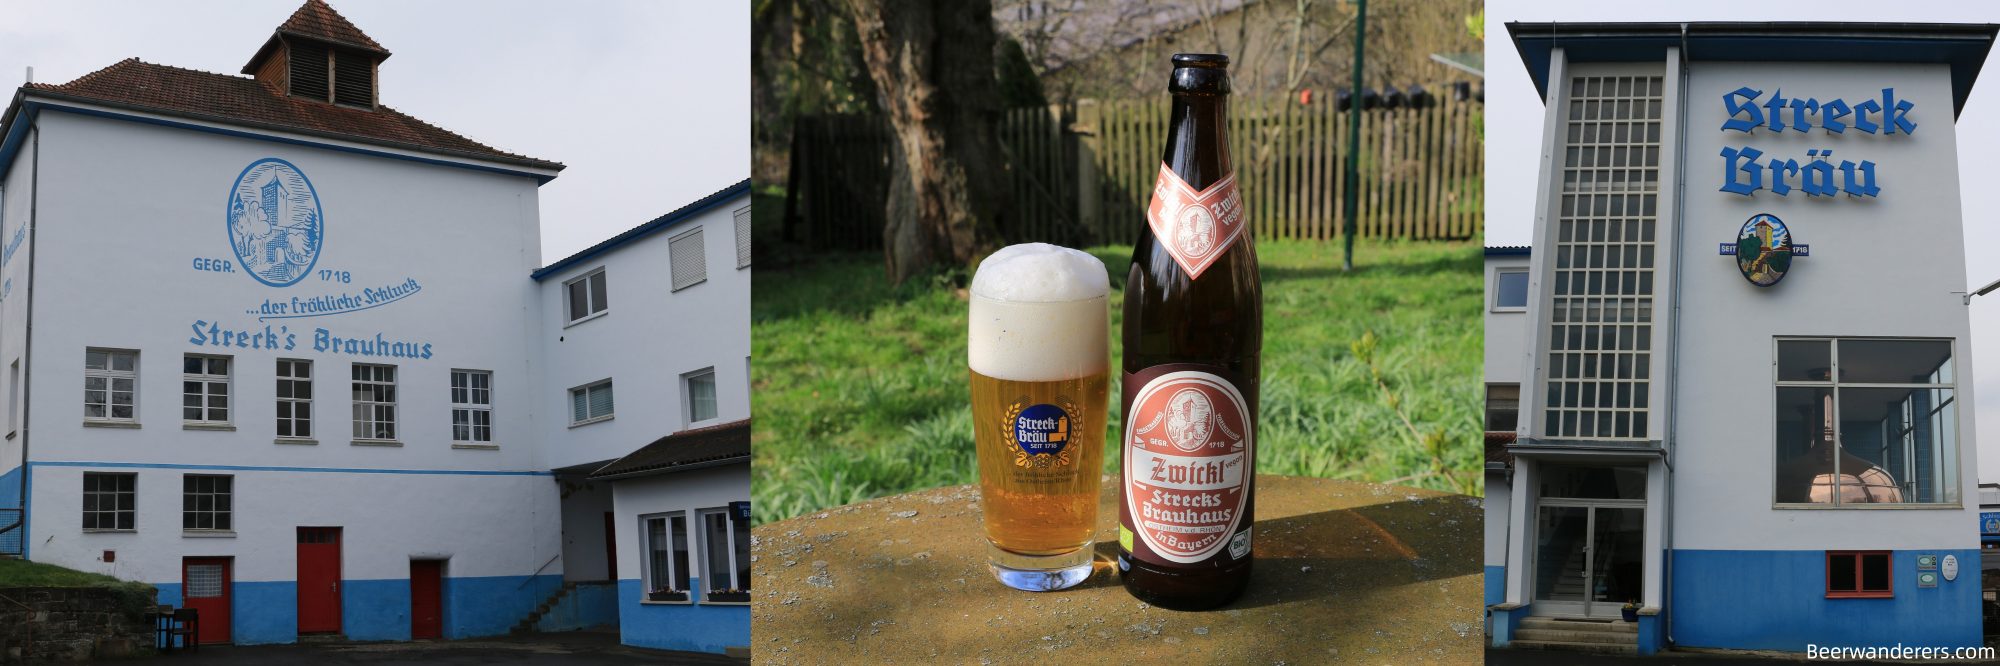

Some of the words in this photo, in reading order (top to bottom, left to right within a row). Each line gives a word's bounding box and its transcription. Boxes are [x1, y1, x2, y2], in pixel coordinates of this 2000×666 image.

[1720, 86, 1918, 135] Streck
[1719, 146, 1881, 197] Bräu
[1721, 245, 1737, 253] SEIT
[1792, 246, 1808, 254] 1718
[193, 257, 236, 273] GEGR.
[318, 269, 351, 284] 1718
[291, 293, 362, 314] fröhliche
[364, 277, 420, 305] Schluck
[189, 319, 297, 351] Streck's
[313, 327, 433, 360] Brauhaus
[1018, 416, 1058, 430] Streck-
[1018, 429, 1047, 443] Bräu
[1149, 438, 1169, 447] GEGR.
[1209, 441, 1225, 449] 1718
[1150, 457, 1225, 485] Zwickl
[1225, 455, 1243, 469] vegan
[1151, 489, 1222, 508] Strecks
[1143, 501, 1232, 524] Brauhaus
[1155, 531, 1167, 543] in
[1167, 534, 1217, 551] Bayern
